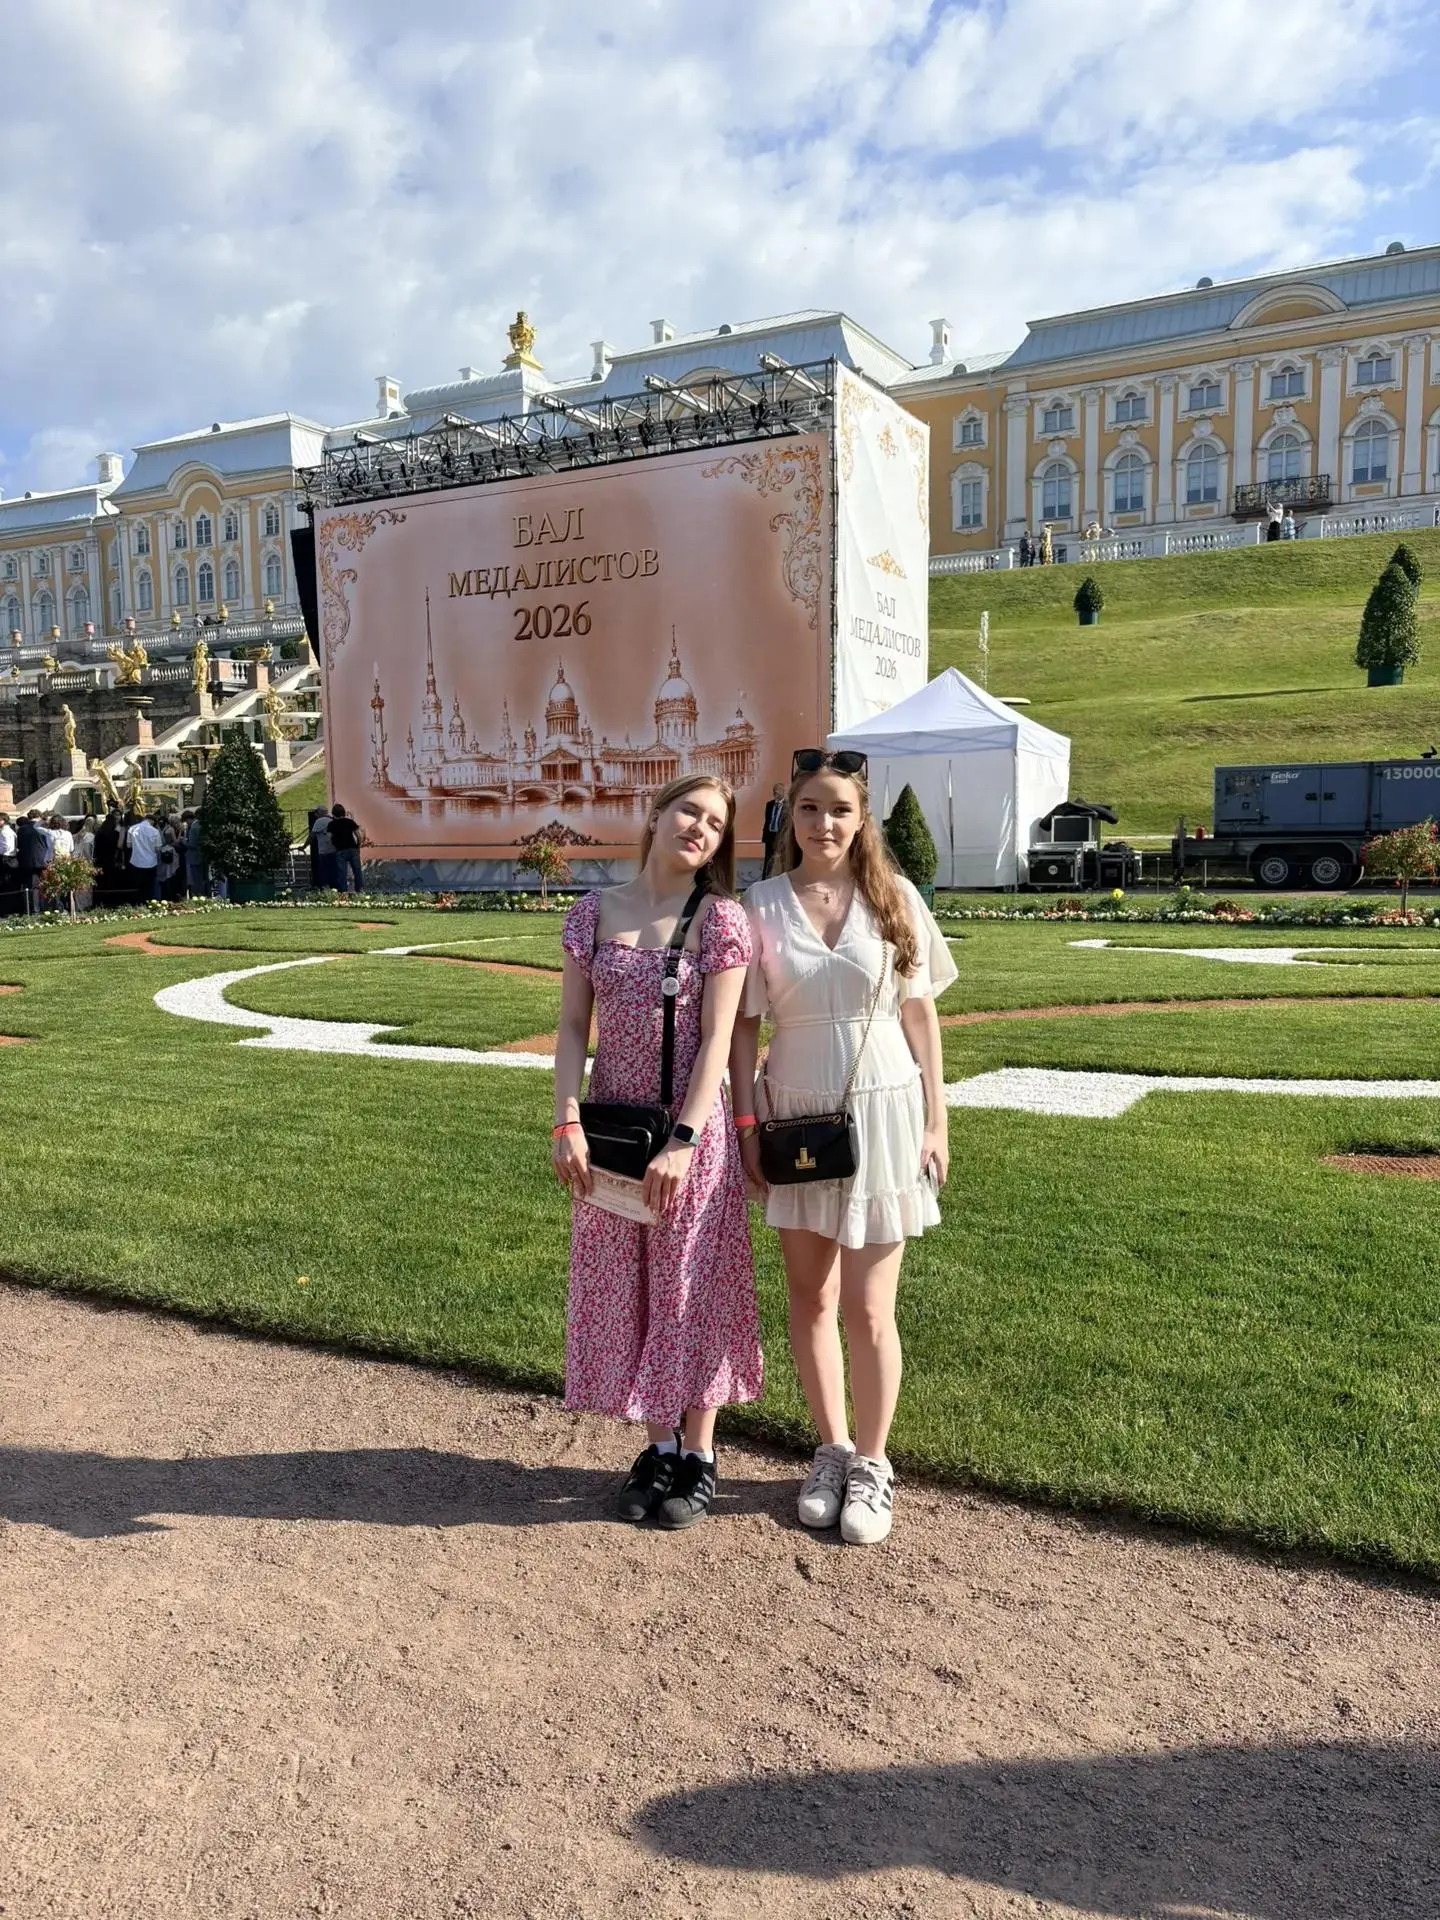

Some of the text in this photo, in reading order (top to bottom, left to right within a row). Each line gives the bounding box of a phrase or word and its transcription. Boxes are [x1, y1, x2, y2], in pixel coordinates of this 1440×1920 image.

[513, 507, 585, 548] БАЛ
[447, 548, 660, 600] МЕДАЛИСТОВ
[513, 600, 592, 641] 2026
[876, 591, 896, 619] БАЛ
[875, 655, 897, 680] 2026
